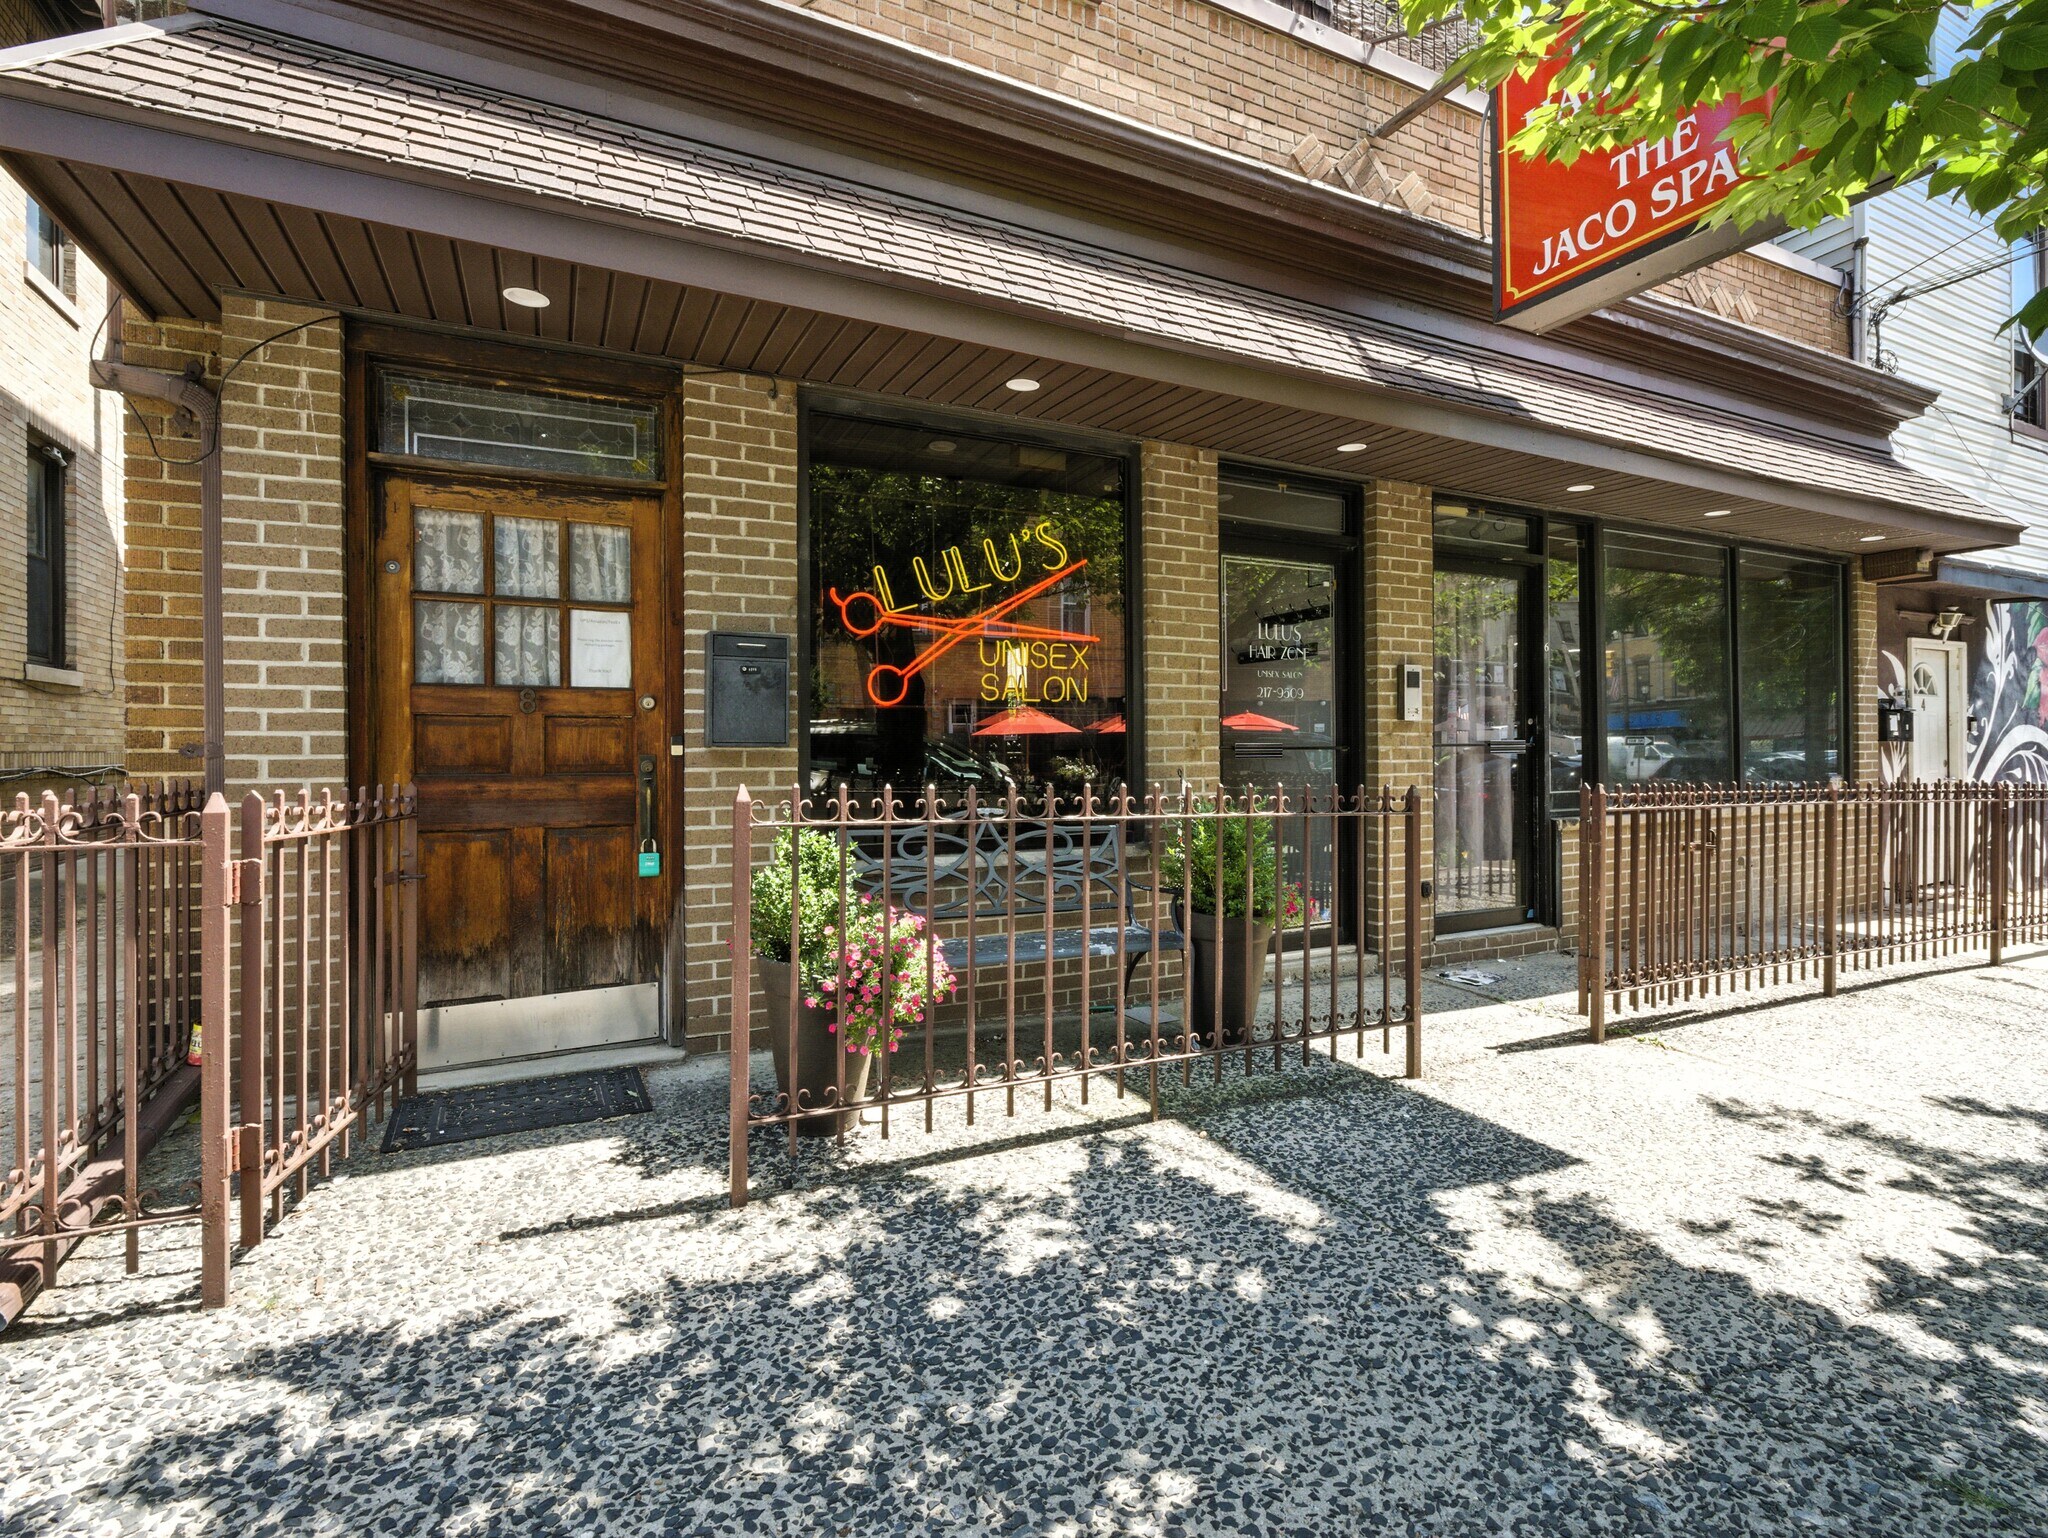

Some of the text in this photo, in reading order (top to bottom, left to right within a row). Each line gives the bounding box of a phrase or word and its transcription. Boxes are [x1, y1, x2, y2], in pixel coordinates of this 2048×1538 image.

[1608, 113, 1699, 190] THE
[1533, 198, 1637, 276] JACO
[874, 522, 1068, 613] LULU'S
[979, 638, 1089, 670] UNISEX
[1249, 645, 1309, 661] HAIR ZONE
[1544, 642, 1550, 652] 6
[980, 673, 1088, 702] SALON
[1257, 670, 1303, 679] UNISEX SALON
[519, 688, 536, 714] 8
[1257, 686, 1304, 699] 217-9509
[1920, 698, 1926, 711] 4
